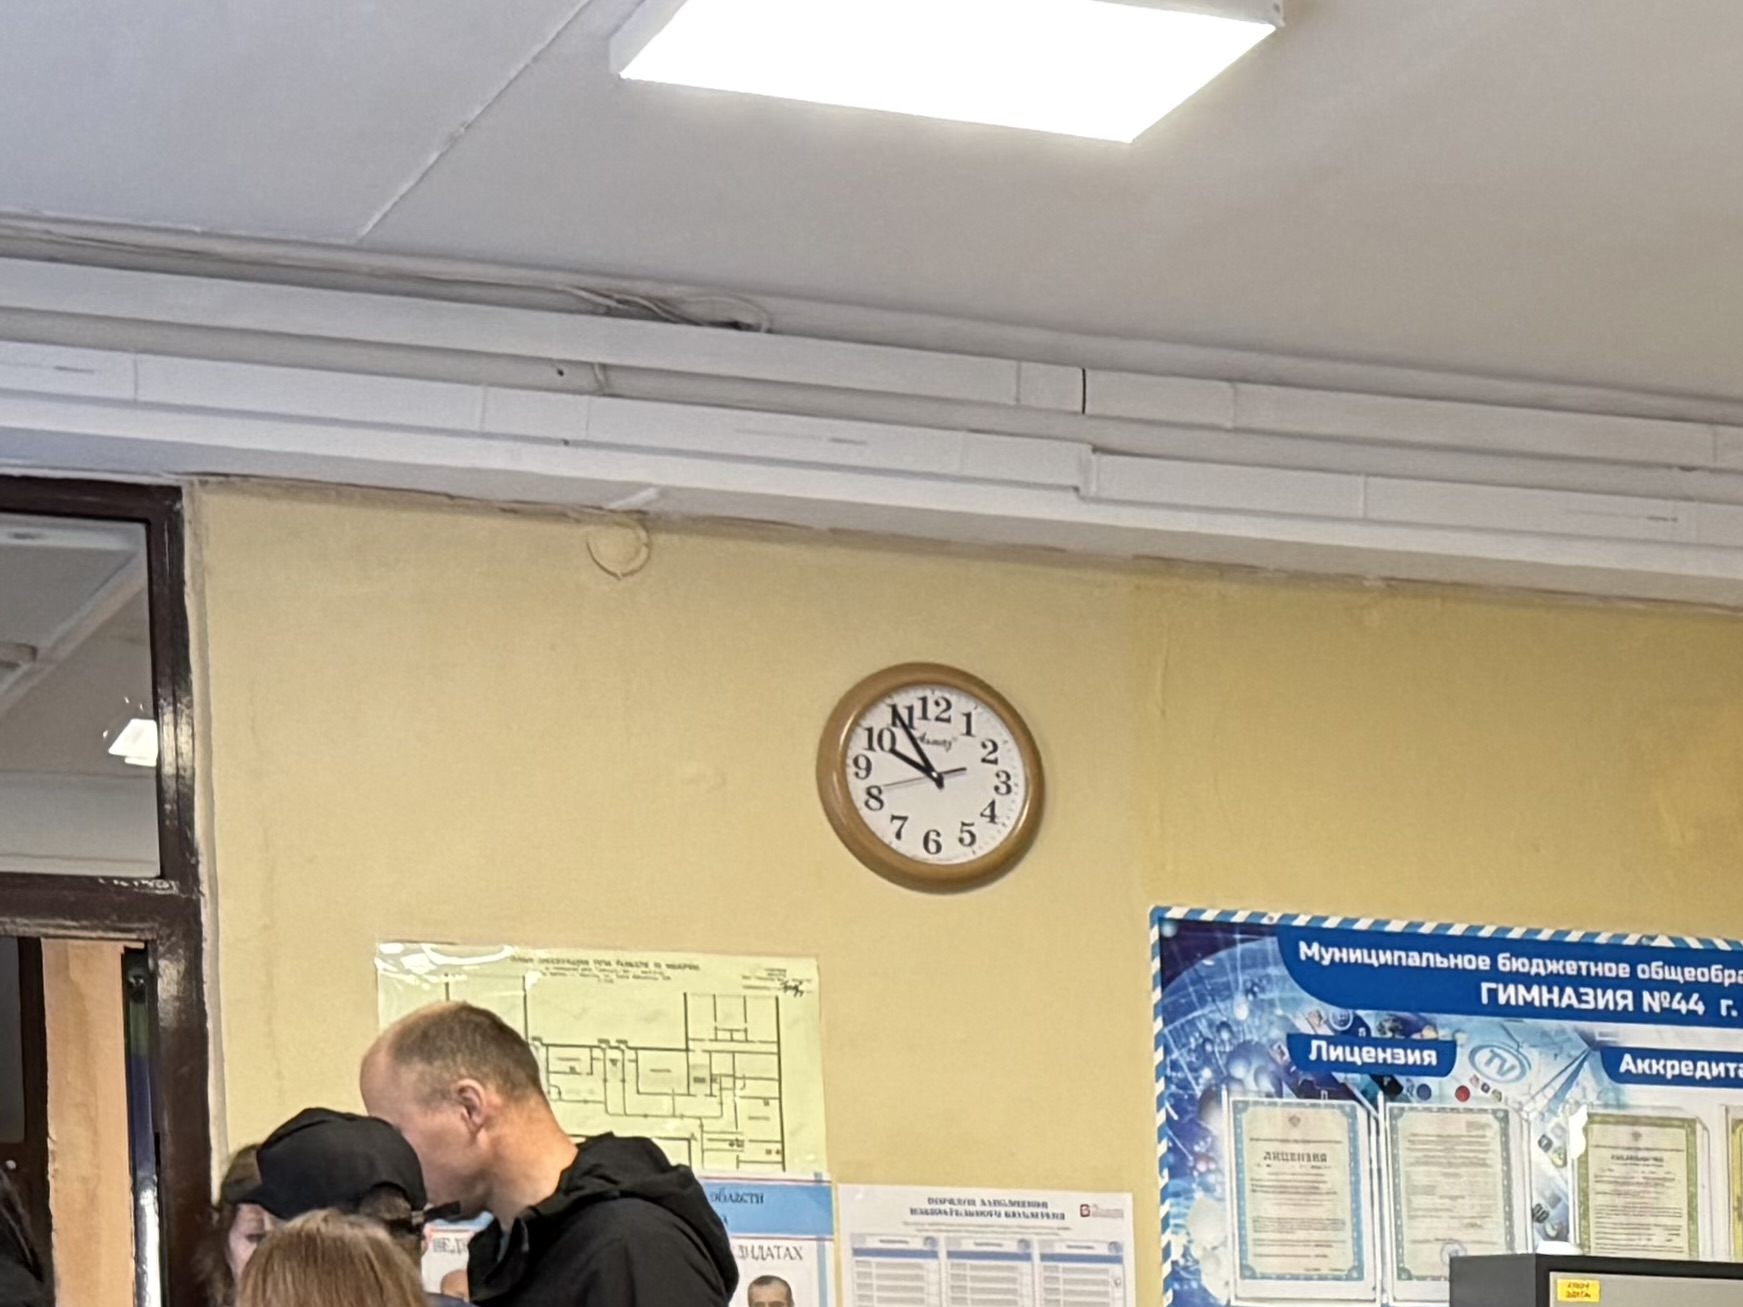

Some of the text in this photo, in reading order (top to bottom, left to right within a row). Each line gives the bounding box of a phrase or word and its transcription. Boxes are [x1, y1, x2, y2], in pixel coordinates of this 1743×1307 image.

[917, 696, 953, 723] 12
[961, 711, 976, 737] 1
[864, 727, 896, 753] 10
[981, 739, 999, 765] 2
[853, 754, 874, 780] 9
[994, 770, 1012, 796] 3
[864, 785, 885, 811] 8
[980, 799, 999, 825] 4
[890, 815, 909, 841] 7
[958, 821, 977, 847] 5
[923, 829, 943, 855] 6
[1299, 941, 1491, 970] Муниципальное
[1498, 952, 1630, 979] бюджетное
[1481, 982, 1634, 1012] ГИМНАЗИЯ
[1642, 989, 1706, 1015] №44
[1720, 997, 1738, 1017] г.
[1308, 1040, 1438, 1067] Лицензия
[738, 1244, 804, 1261] ДИДАТАХ
